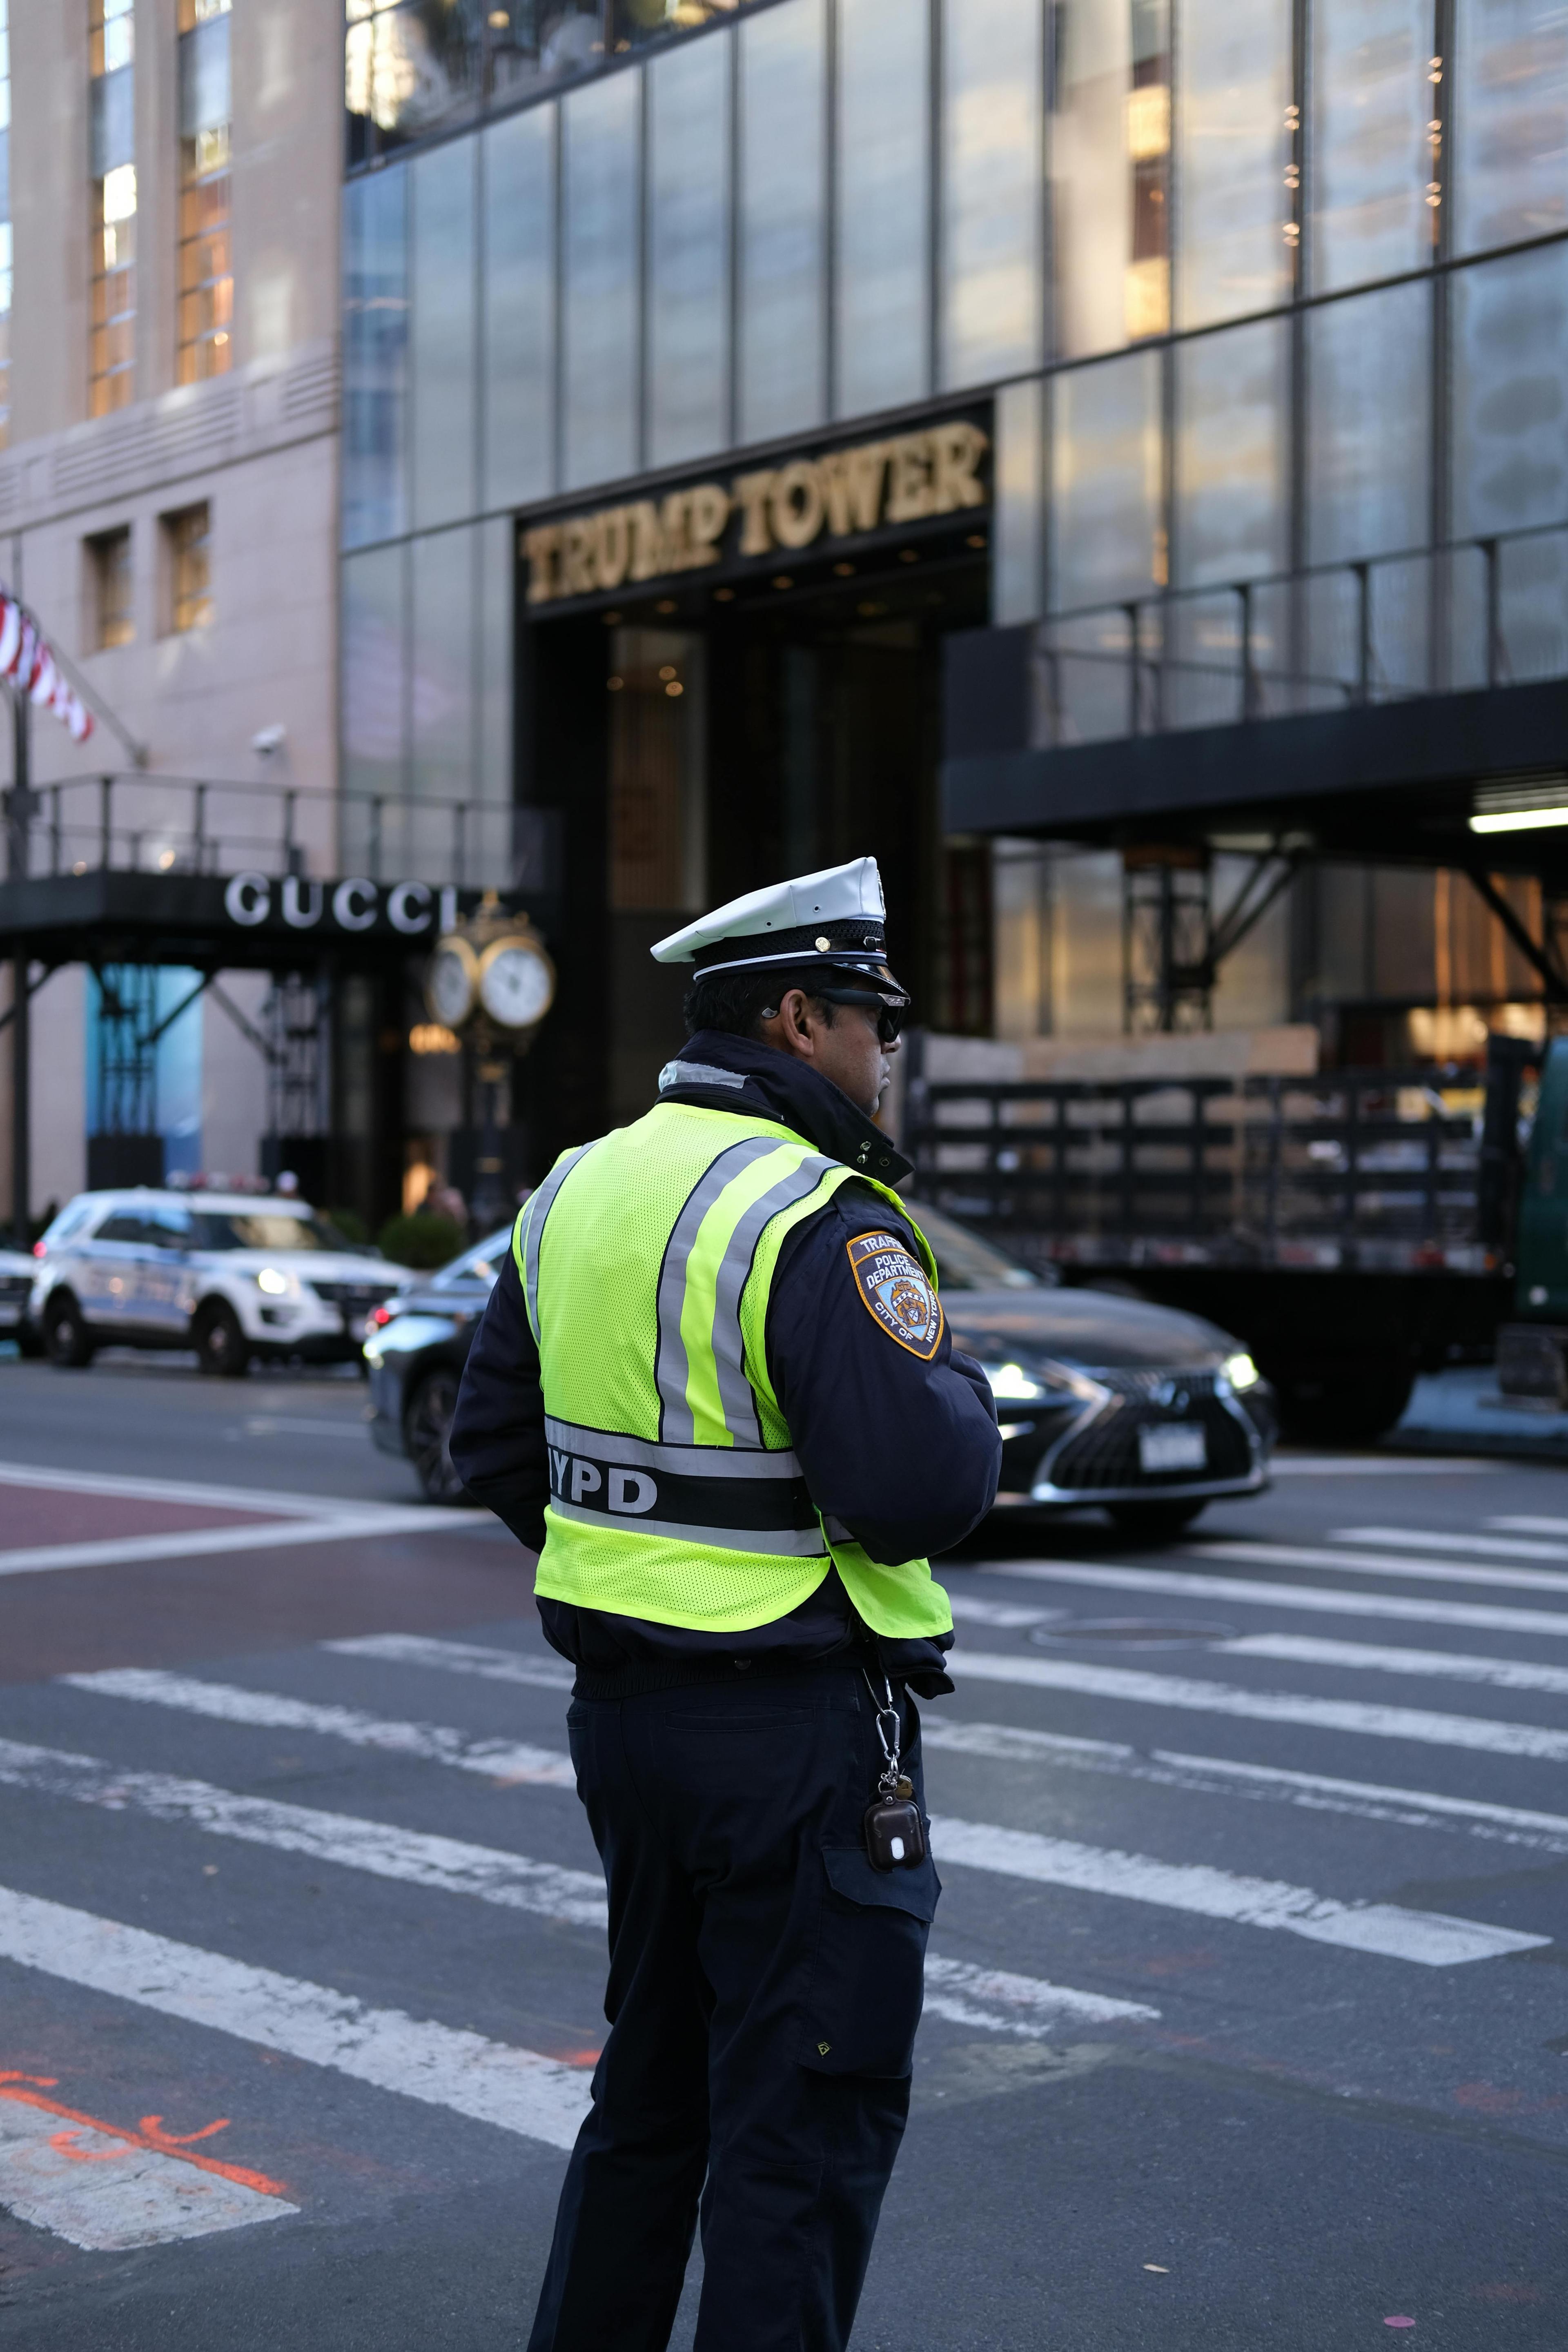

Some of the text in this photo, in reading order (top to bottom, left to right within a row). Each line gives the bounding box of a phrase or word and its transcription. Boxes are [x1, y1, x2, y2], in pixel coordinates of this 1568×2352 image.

[522, 421, 987, 603] TRUMP TOWER
[225, 871, 457, 934] GUCCI
[866, 1265, 926, 1290] DEPARTMENT
[875, 1254, 911, 1269] POLICE
[875, 1289, 938, 1343] CITY OF NEW YORK
